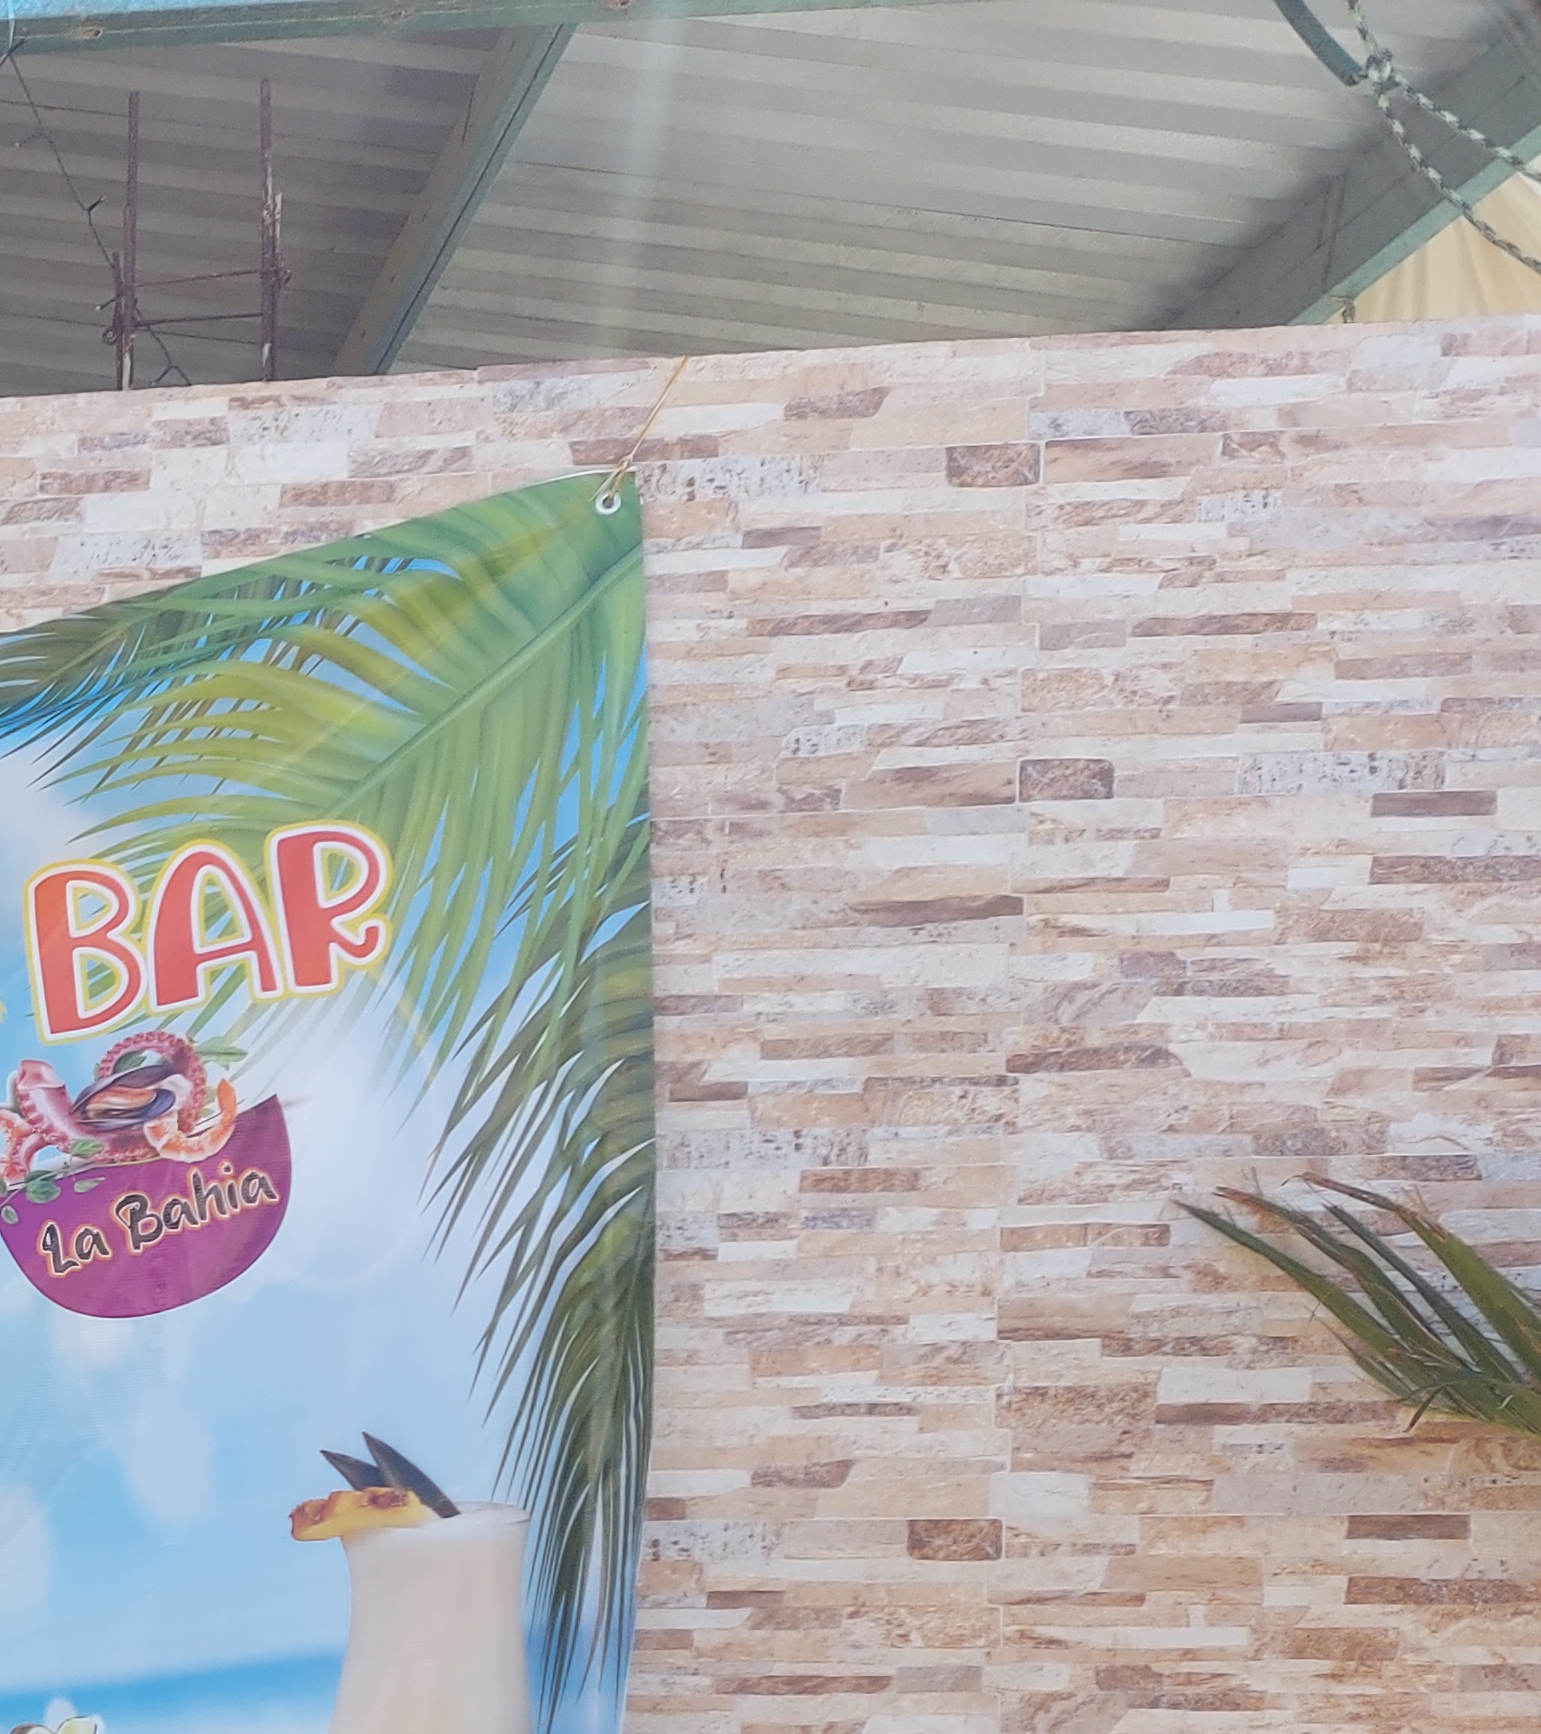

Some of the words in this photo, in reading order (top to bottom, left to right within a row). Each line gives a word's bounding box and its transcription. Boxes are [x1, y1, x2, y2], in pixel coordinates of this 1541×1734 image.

[24, 820, 393, 1045] BAR
[38, 1219, 114, 1280] La
[112, 1160, 280, 1255] Bahia
